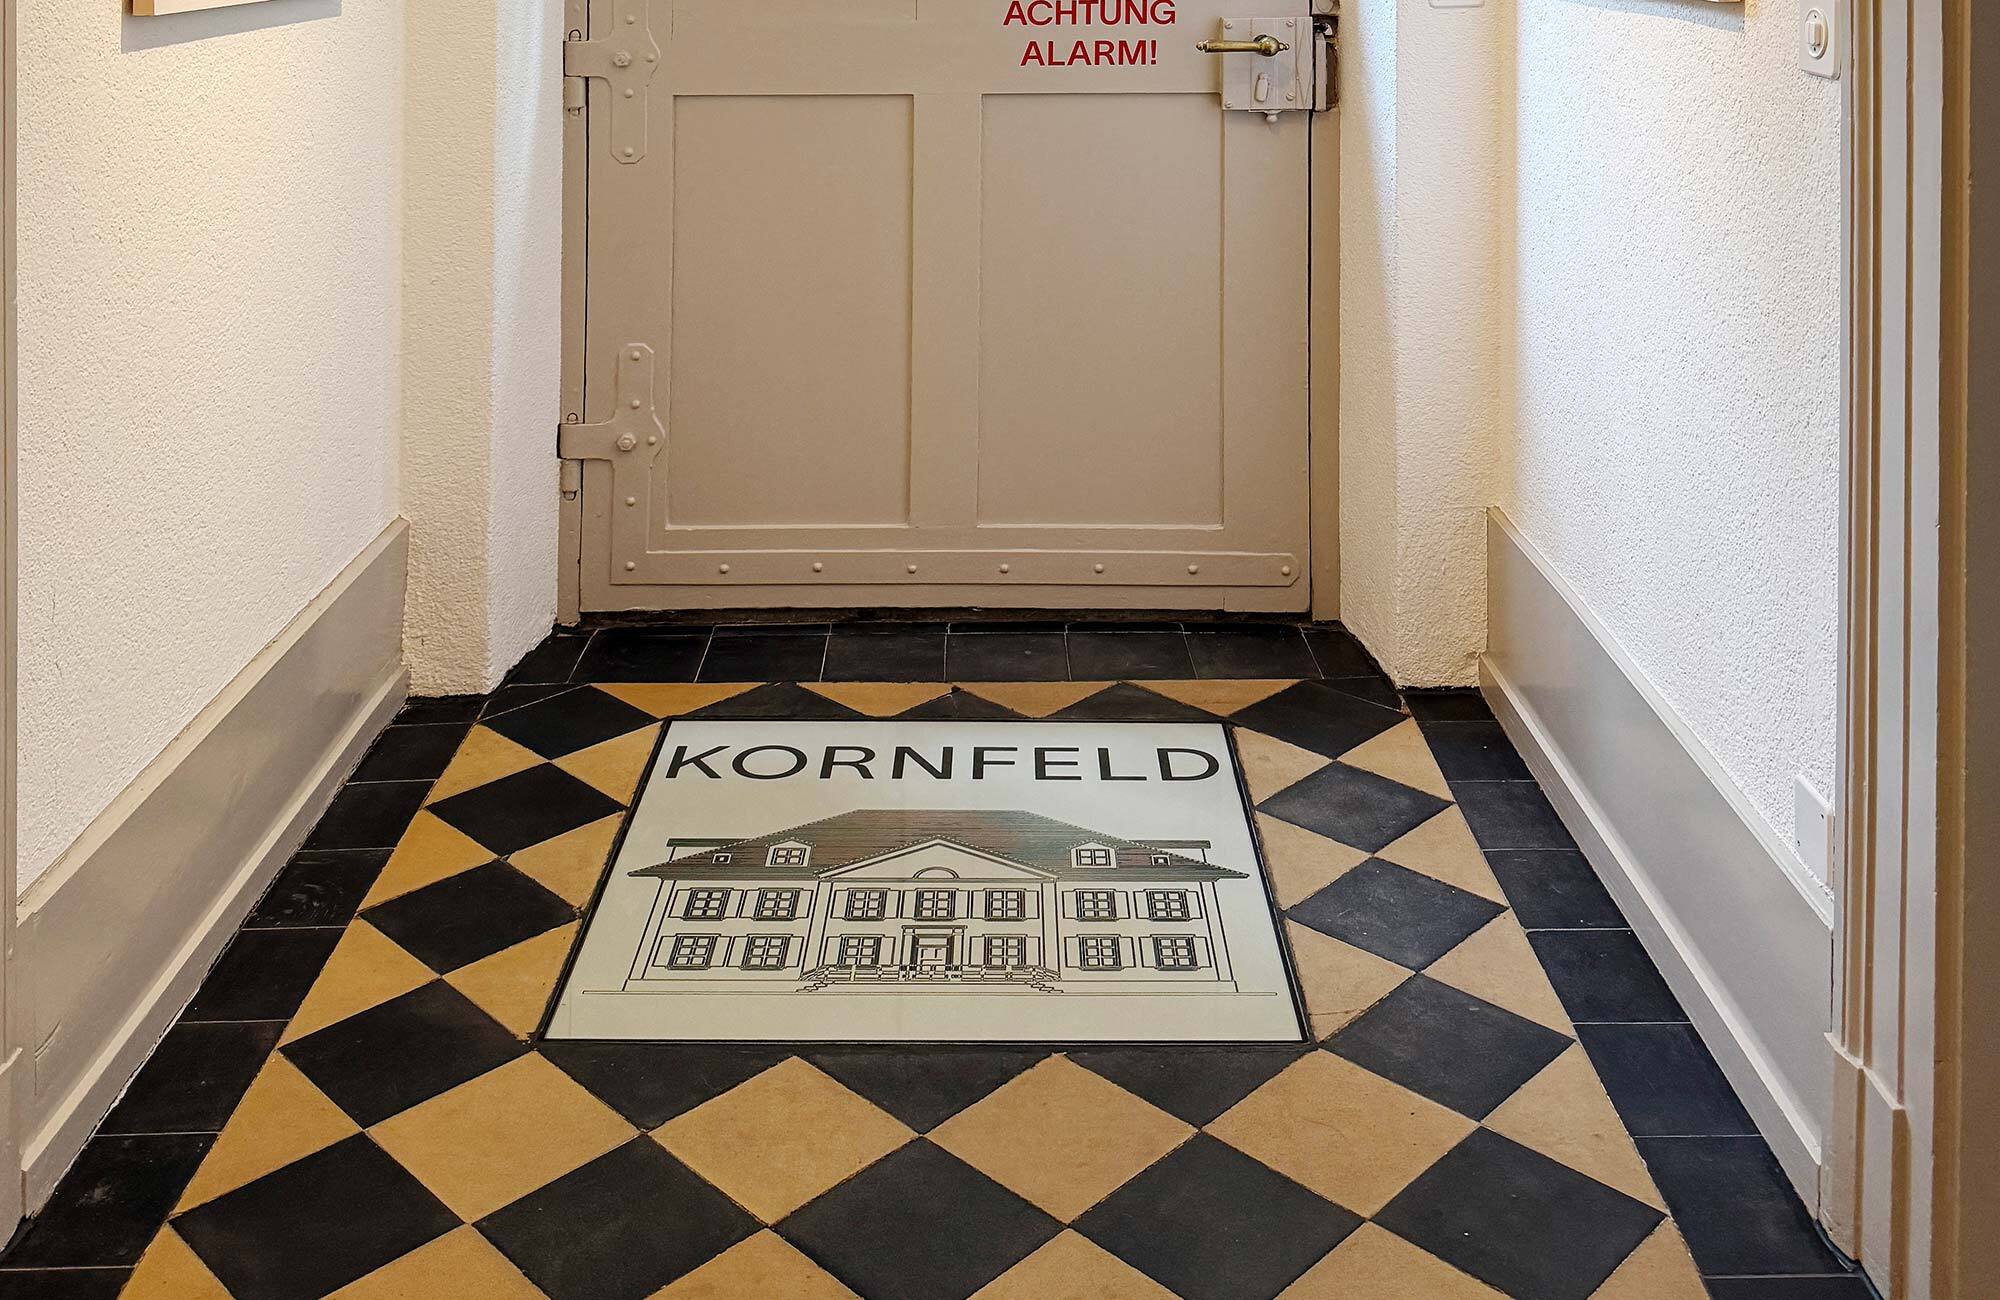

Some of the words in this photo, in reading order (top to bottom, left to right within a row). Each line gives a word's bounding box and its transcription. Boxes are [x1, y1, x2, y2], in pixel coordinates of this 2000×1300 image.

[1003, 0, 1176, 25] ACHTUNG
[1020, 40, 1157, 65] ALARM!
[665, 745, 1220, 781] KORNFELD
